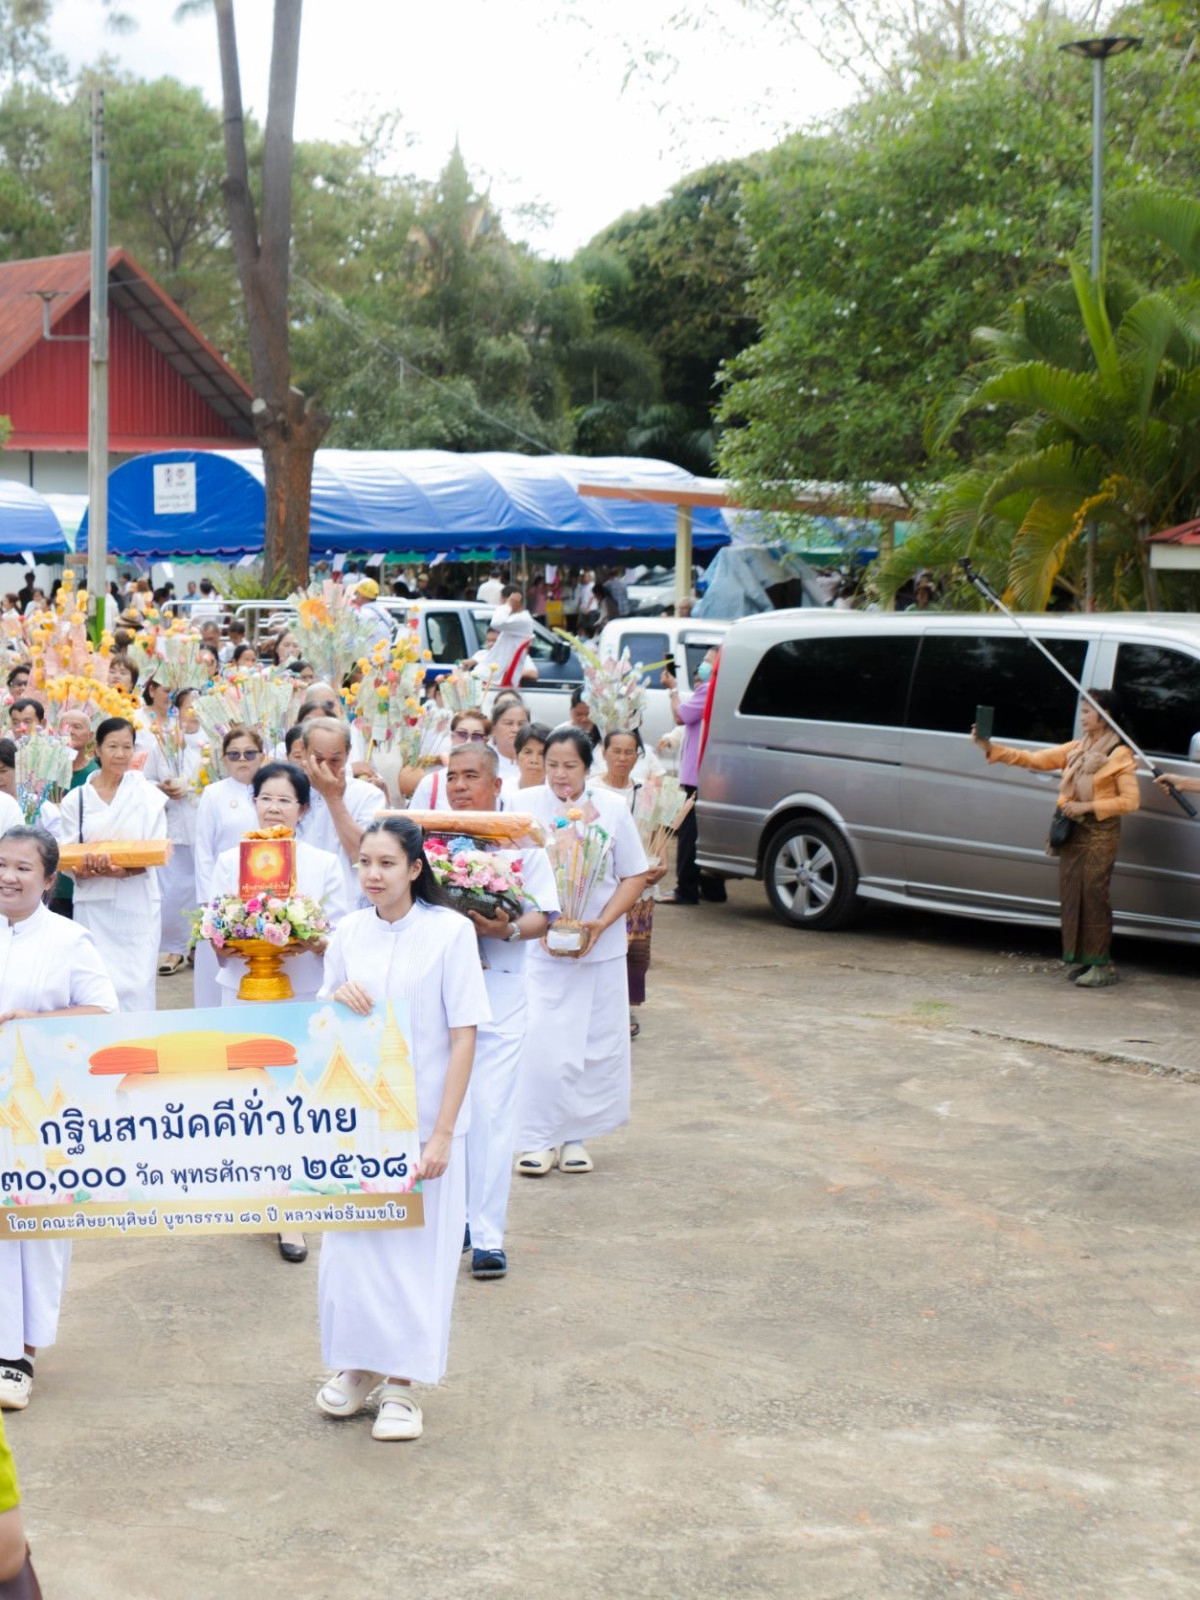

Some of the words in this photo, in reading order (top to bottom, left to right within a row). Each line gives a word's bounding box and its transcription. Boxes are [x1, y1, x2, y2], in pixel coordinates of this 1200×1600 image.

[40, 1088, 358, 1155] กฐินสามัคคีทั่วไทย
[1, 1166, 127, 1195] ๓๐,๐๐๐
[136, 1162, 164, 1186] วัด
[171, 1159, 292, 1193] พุทธศักราช
[301, 1152, 408, 1180] ๒๕๖๘
[8, 1215, 36, 1230] โดย
[163, 1211, 234, 1230] บูชาธรรม
[266, 1206, 278, 1222] ปี
